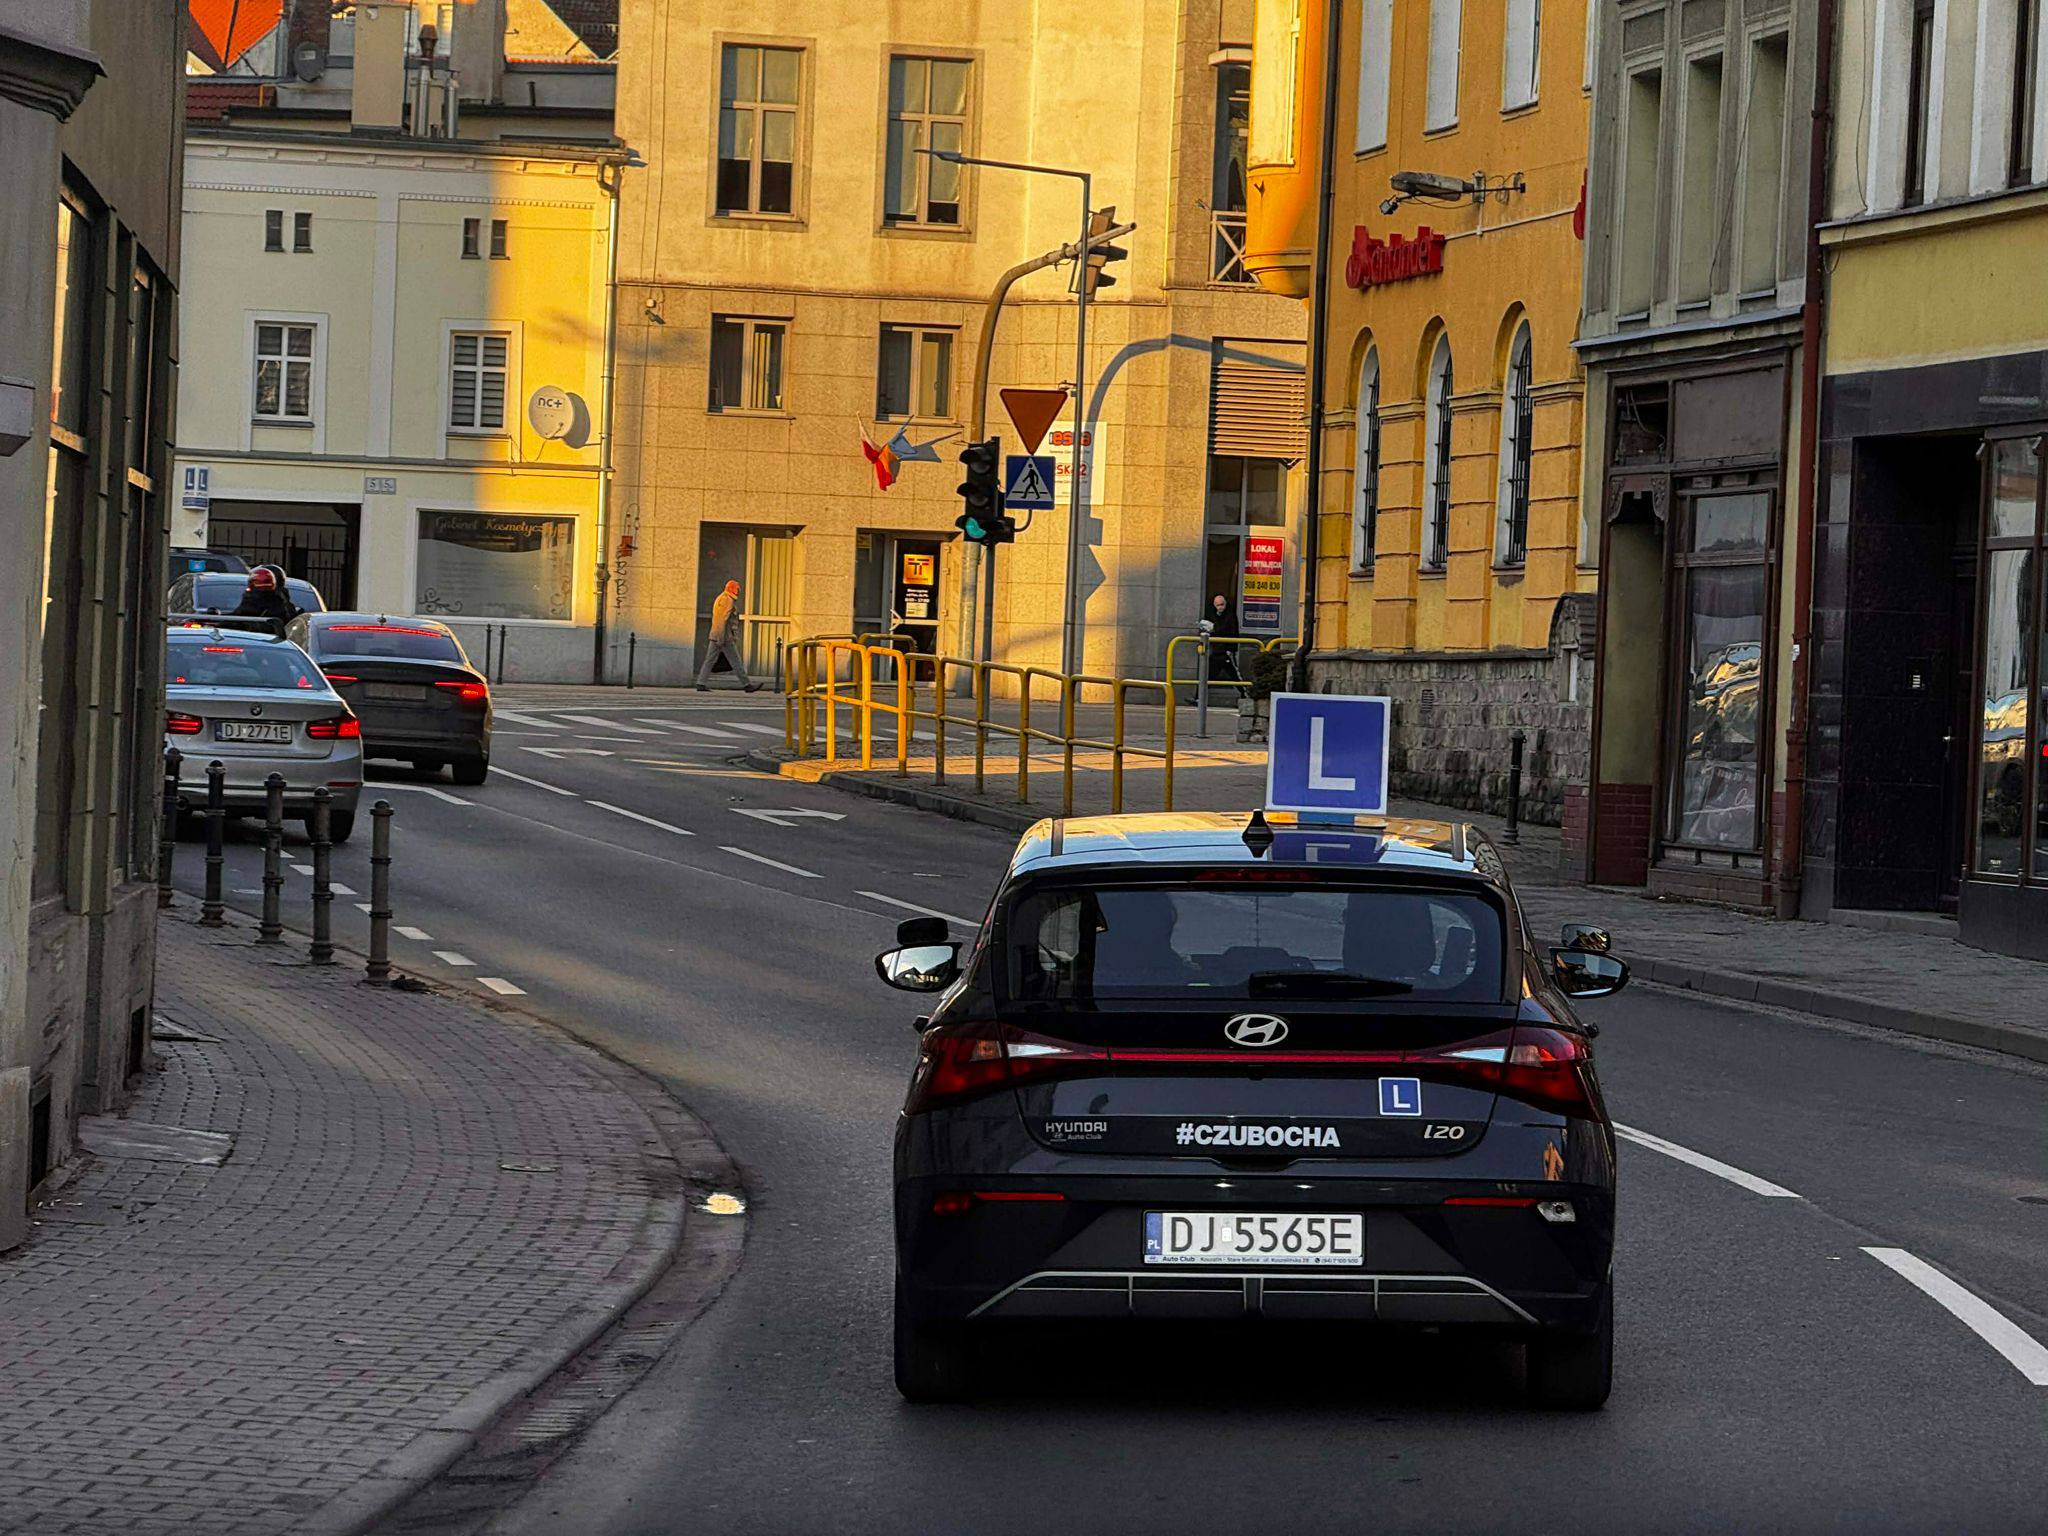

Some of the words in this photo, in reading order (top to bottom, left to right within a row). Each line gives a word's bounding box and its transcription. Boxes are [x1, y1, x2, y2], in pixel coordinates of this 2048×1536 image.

[538, 397, 563, 408] nc+
[187, 471, 193, 487] L
[200, 472, 206, 488] L
[436, 516, 478, 533] Gabinet
[1251, 545, 1277, 553] LOKAL
[225, 723, 242, 738] DJ
[247, 725, 289, 739] 2771E
[1308, 717, 1356, 791] L
[1393, 1085, 1411, 1108] L
[1045, 1121, 1107, 1133] HYUNDAI
[1175, 1123, 1341, 1148] #CZUBOCHA
[1170, 1216, 1215, 1253] DJ
[1234, 1217, 1352, 1254] 5565E
[1147, 1239, 1161, 1250] PL
